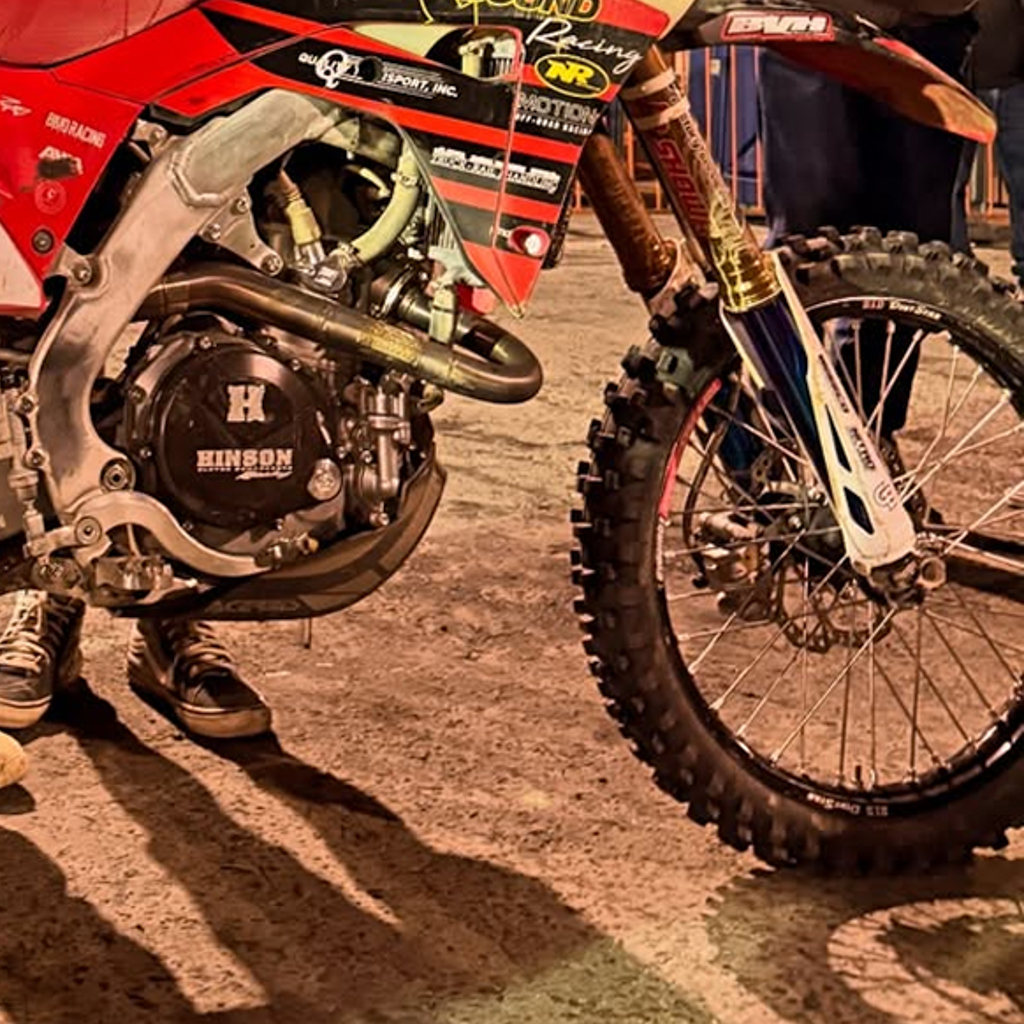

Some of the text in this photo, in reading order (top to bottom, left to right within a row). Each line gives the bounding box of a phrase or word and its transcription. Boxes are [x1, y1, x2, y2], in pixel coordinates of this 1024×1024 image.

[524, 17, 644, 75] Racing
[432, 84, 459, 98] INC.
[226, 383, 266, 423] H
[196, 448, 294, 468] HINSON
